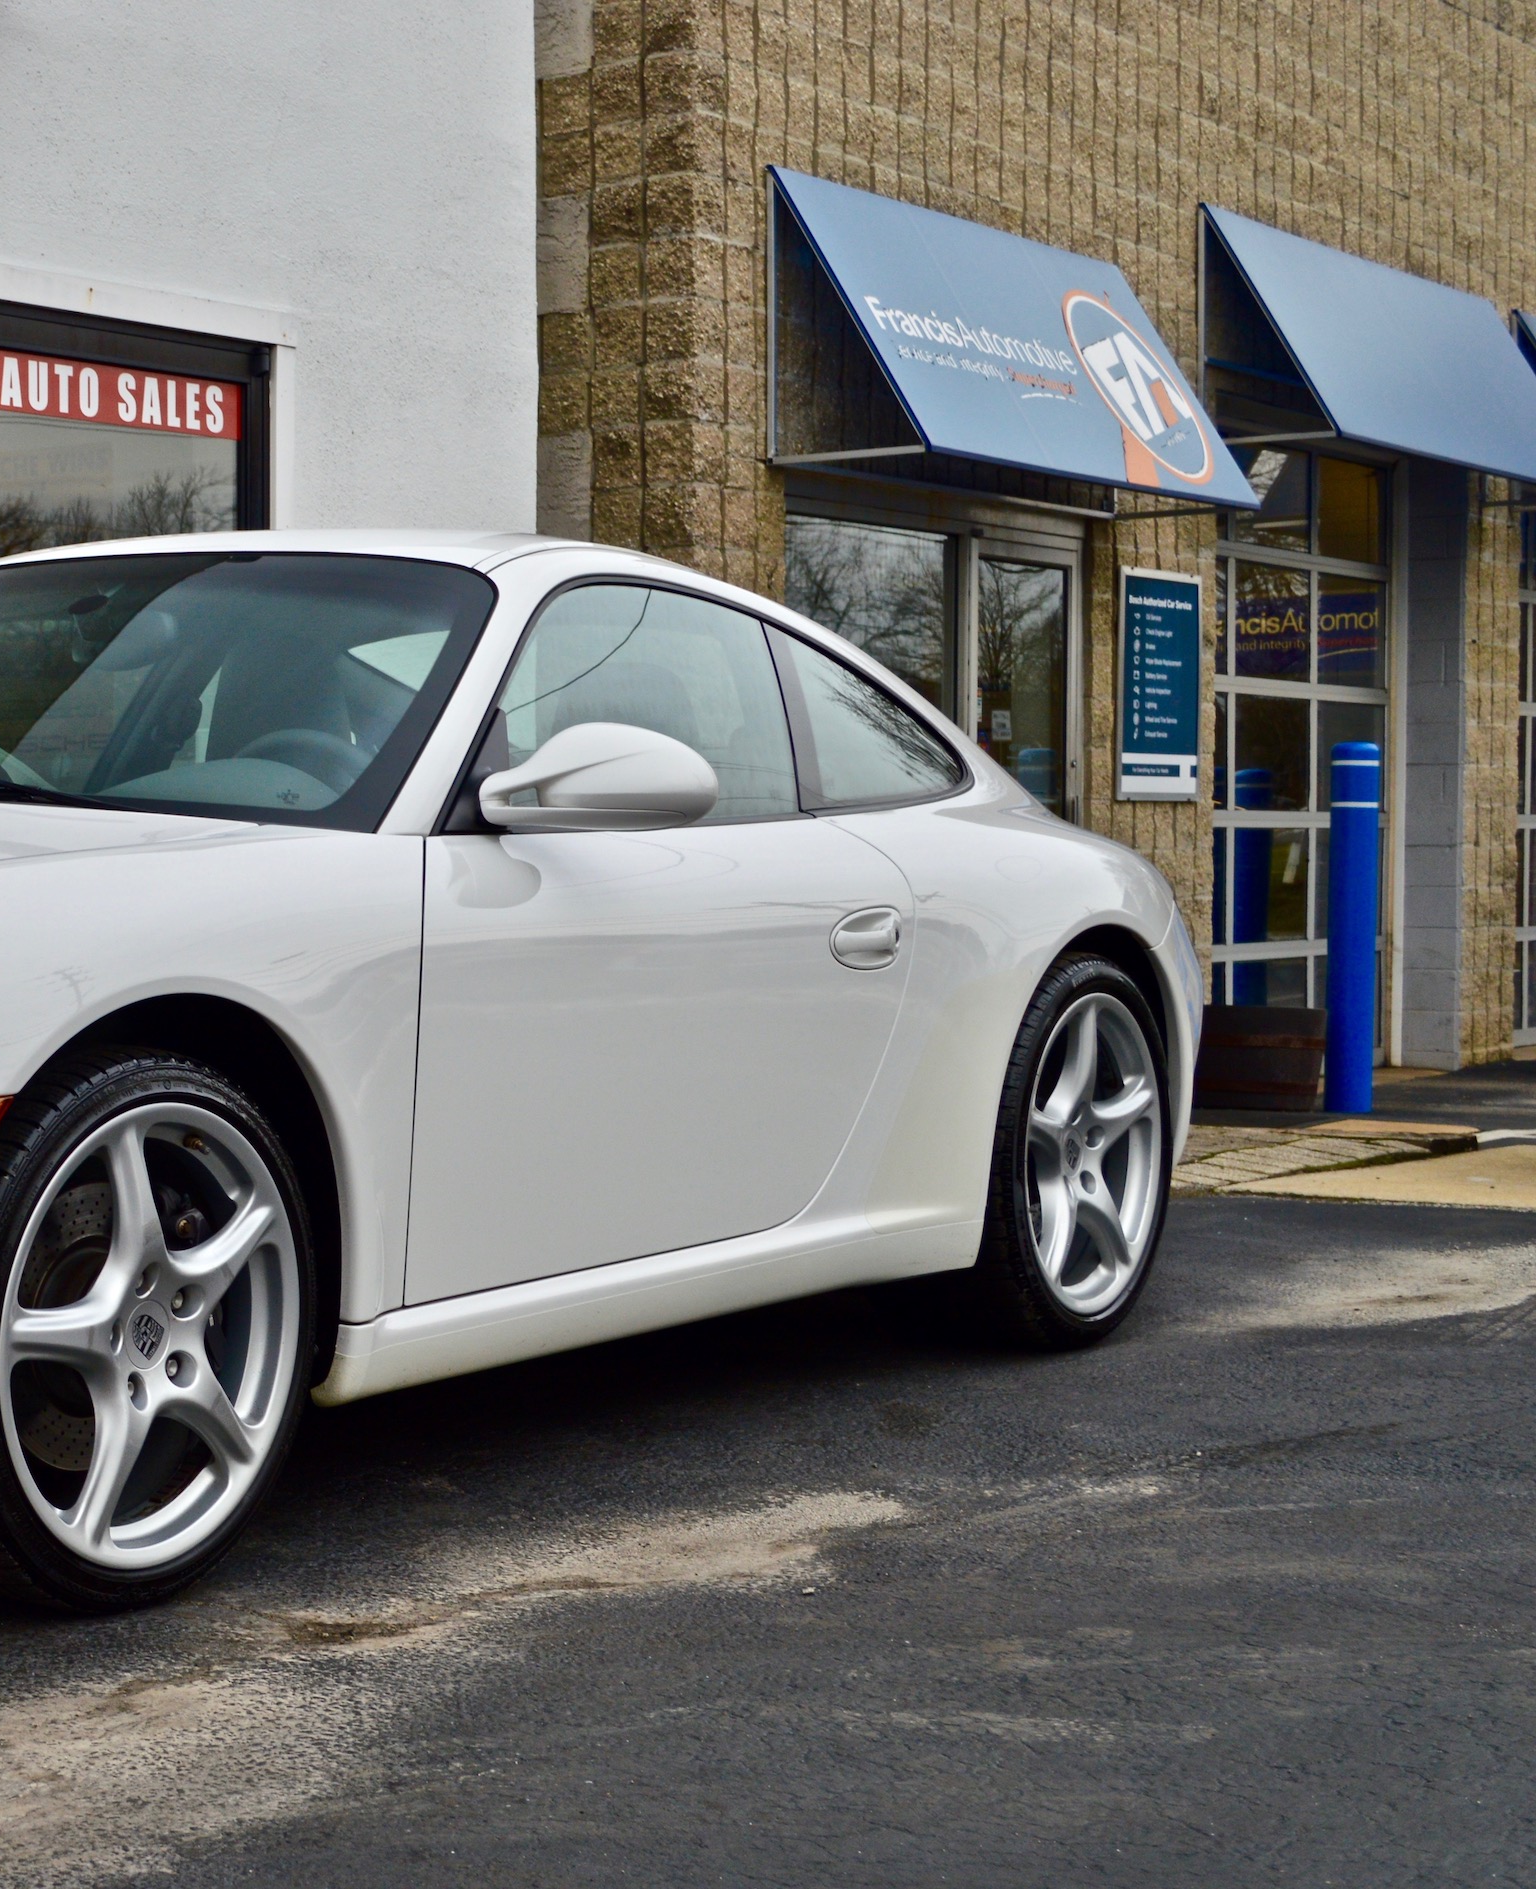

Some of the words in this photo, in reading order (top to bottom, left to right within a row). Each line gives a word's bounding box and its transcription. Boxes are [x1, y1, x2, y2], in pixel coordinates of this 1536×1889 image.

[864, 296, 1077, 375] FrancisAutomotive
[0, 356, 99, 418] AUTO
[117, 373, 224, 434] SALES
[1129, 595, 1142, 605] Bosch
[1144, 597, 1166, 608] Authorized
[1167, 600, 1175, 609] Car
[1175, 600, 1192, 611] Service
